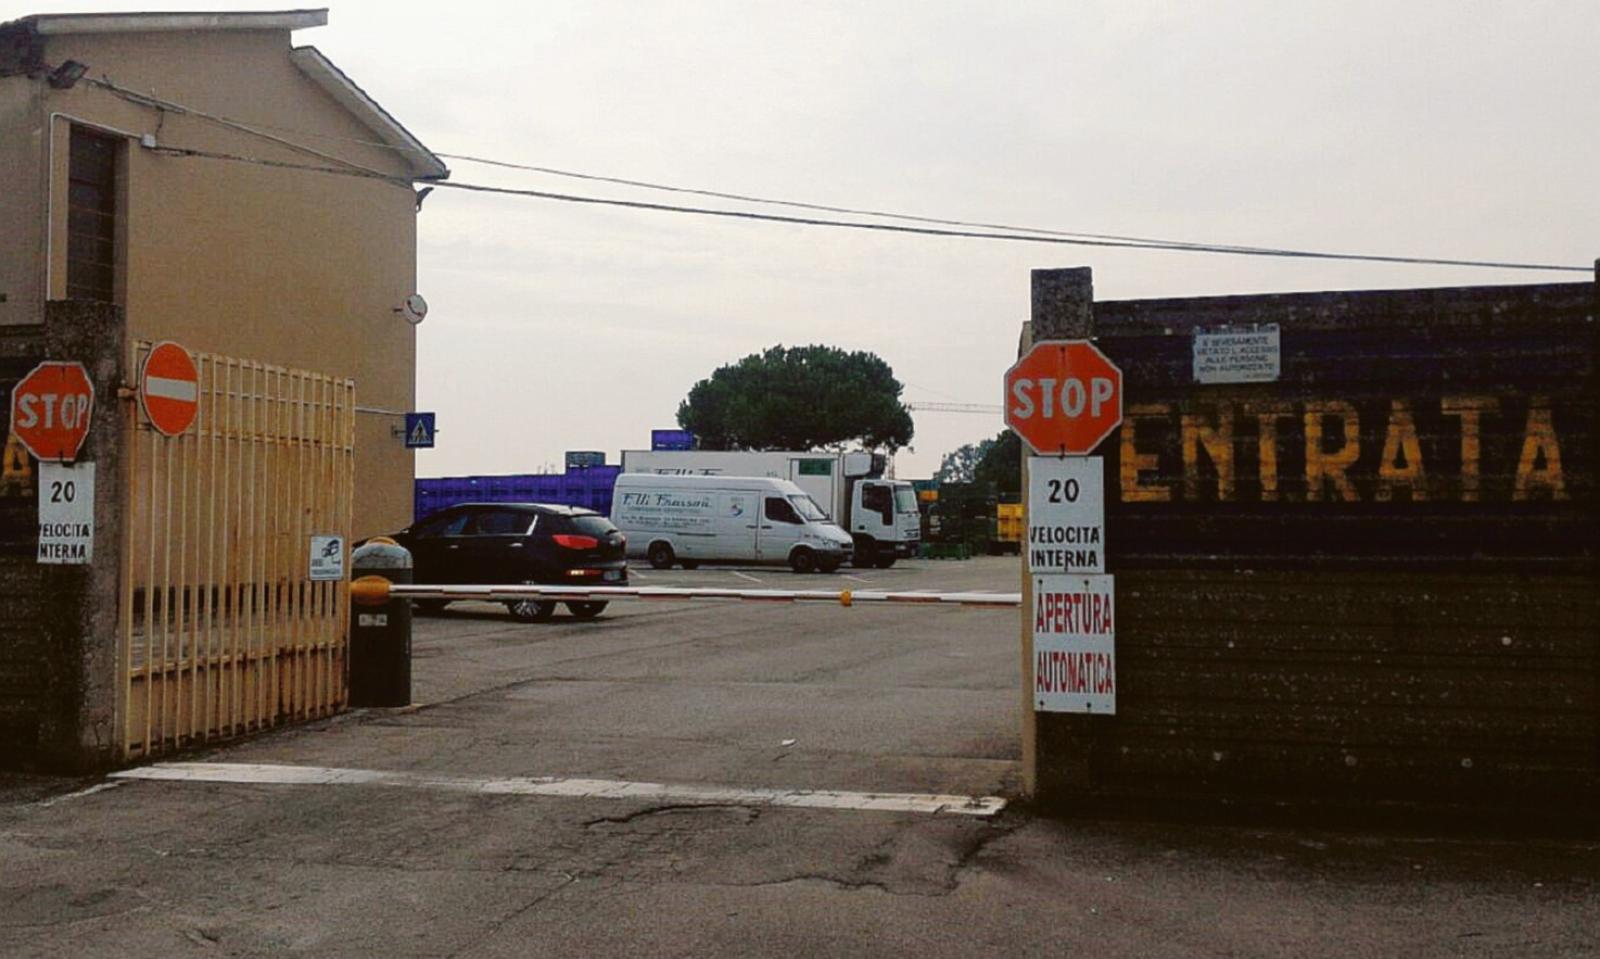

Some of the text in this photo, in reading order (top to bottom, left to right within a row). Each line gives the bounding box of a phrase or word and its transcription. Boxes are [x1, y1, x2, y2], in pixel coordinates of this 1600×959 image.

[1199, 364, 1217, 373] NON
[1229, 354, 1268, 363] PERSONE
[1014, 378, 1113, 418] STOP
[17, 392, 88, 430] STOP
[1120, 397, 1569, 501] ENTRATA
[51, 481, 75, 503] 20
[1048, 478, 1079, 503] 20
[40, 543, 86, 560] NTERNA
[1031, 550, 1098, 567] INTERNA
[1036, 593, 1112, 634] APERTURA
[1036, 651, 1113, 694] AUTOMATICA
